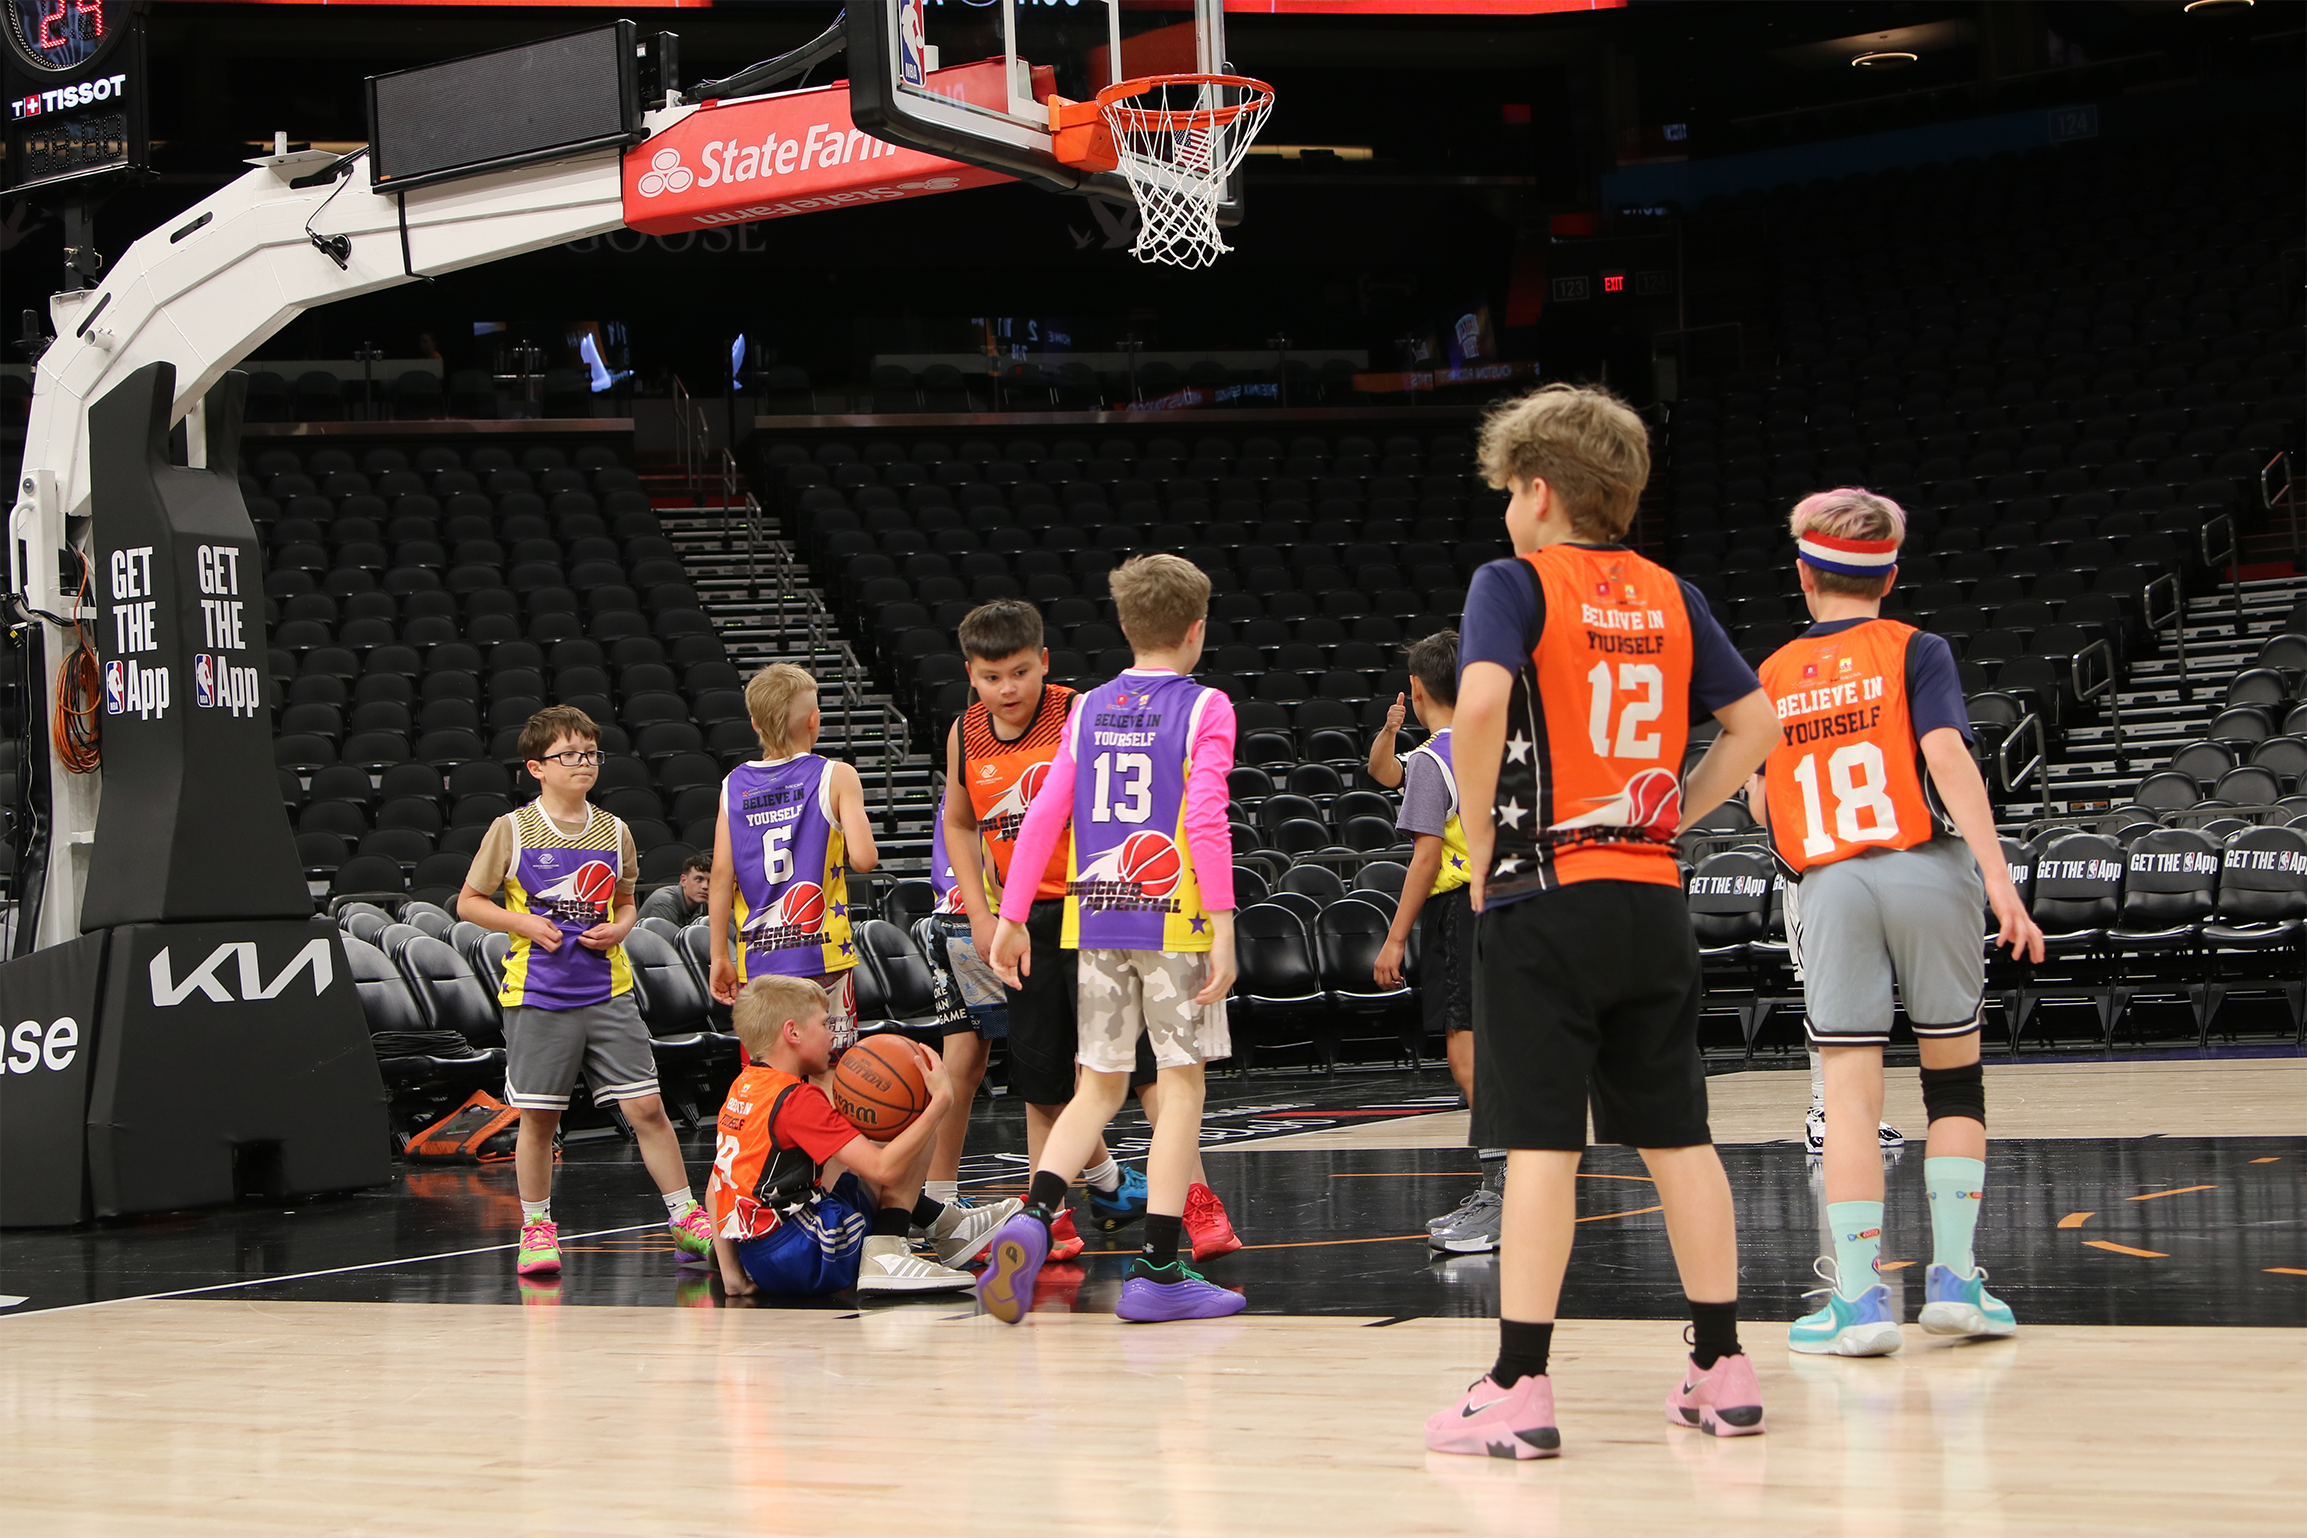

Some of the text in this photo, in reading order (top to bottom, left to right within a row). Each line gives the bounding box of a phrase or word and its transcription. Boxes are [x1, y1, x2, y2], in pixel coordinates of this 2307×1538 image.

[904, 62, 918, 80] NBA
[42, 74, 126, 113] TISSOT
[2057, 112, 2088, 136] 124
[1560, 280, 1585, 298] 123
[1604, 275, 1625, 292] EXIT
[111, 546, 153, 600] GET
[197, 544, 240, 595] GET
[112, 601, 158, 654] THE
[200, 599, 246, 650] THE
[1647, 610, 1665, 629] IN
[127, 659, 170, 720] App
[217, 655, 259, 718] App
[1776, 682, 1859, 720] BELIEVE
[1863, 675, 1883, 700] IN
[1094, 713, 1162, 728] BELIEVE IN
[1587, 660, 1663, 759] 12
[1783, 705, 1881, 747] YOURSELF
[1094, 731, 1156, 747] YOURSELF
[743, 787, 805, 810] BELIEVE IN
[1091, 751, 1153, 824] 13
[1793, 741, 1900, 858] 18
[745, 804, 803, 827] YOURSELF
[762, 824, 795, 886] 6
[2130, 851, 2218, 874] GET THE App
[2224, 849, 2307, 875] GET THE Ap
[1772, 873, 1785, 892] GE
[2036, 859, 2122, 882] GET THE App
[1065, 881, 1142, 897] UNLOCKED
[1688, 875, 1767, 897] GET THE App
[1085, 896, 1182, 914] POTENTIAL
[753, 931, 832, 954] POTENTIAL
[939, 1008, 968, 1026] GAME
[0, 1016, 79, 1075] se
[832, 1089, 878, 1125] Wilso
